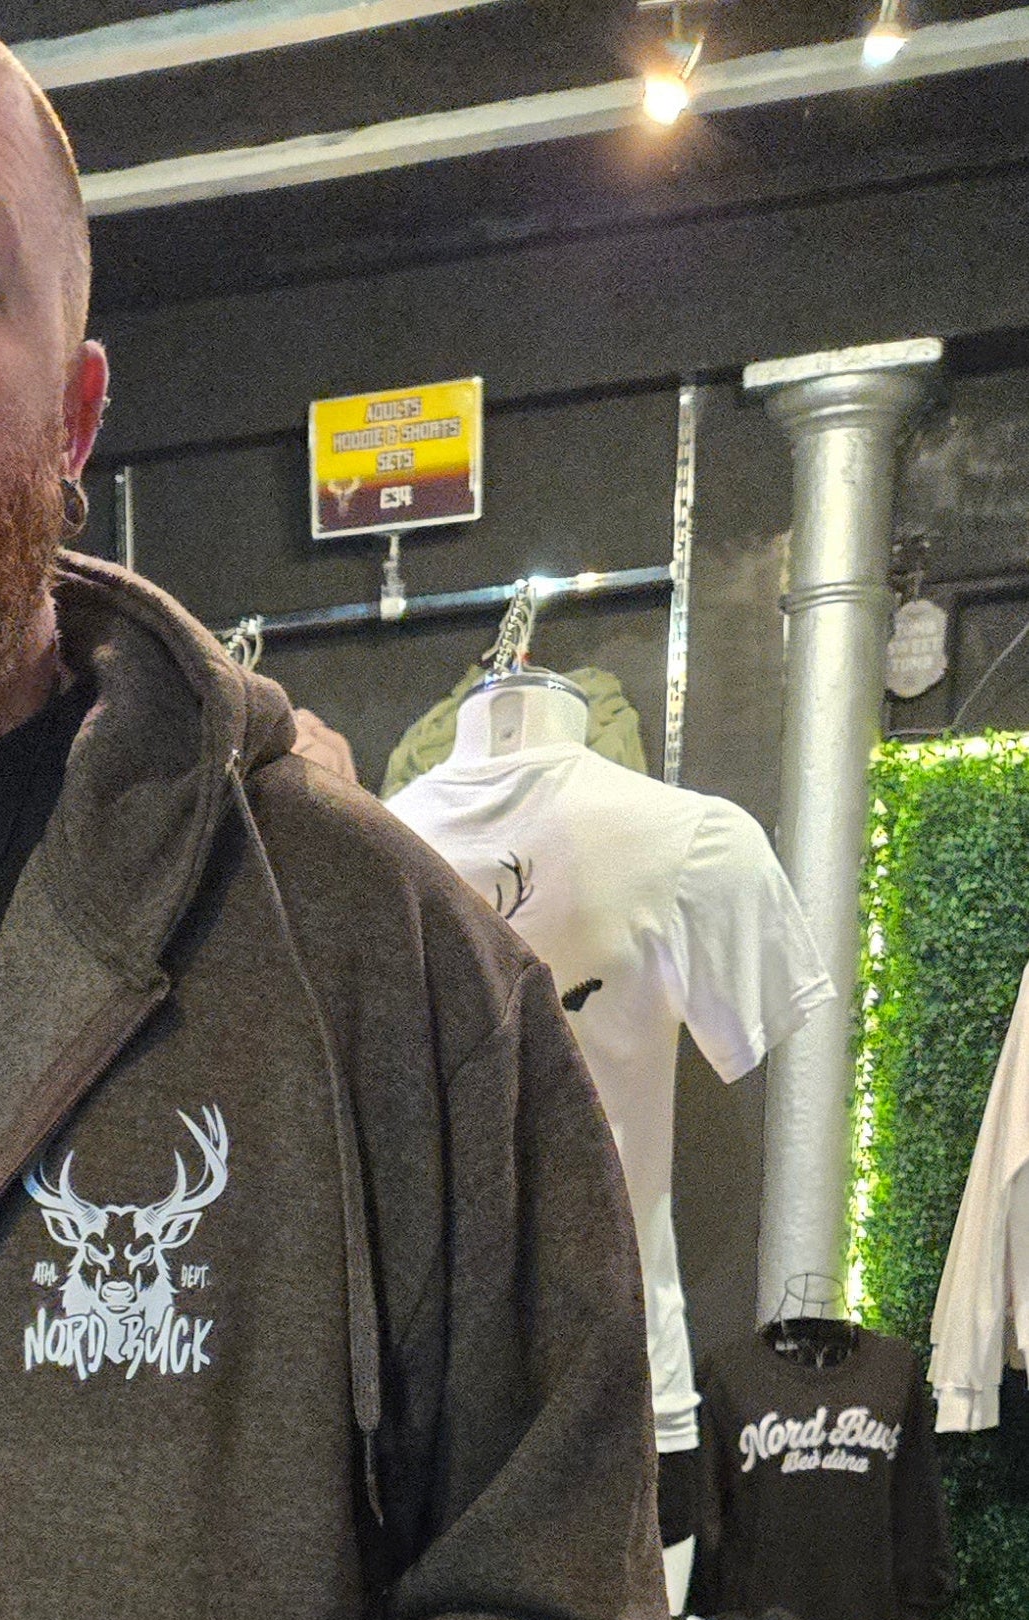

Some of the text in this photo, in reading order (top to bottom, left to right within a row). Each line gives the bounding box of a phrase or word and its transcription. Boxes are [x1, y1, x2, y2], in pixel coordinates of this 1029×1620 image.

[364, 397, 422, 424] ADULTS
[331, 426, 385, 454] HOODIE
[400, 416, 460, 443] SHORTS
[376, 448, 415, 472] SETS
[24, 1306, 213, 1380] NORD BUCK
[739, 1406, 828, 1473] Nord
